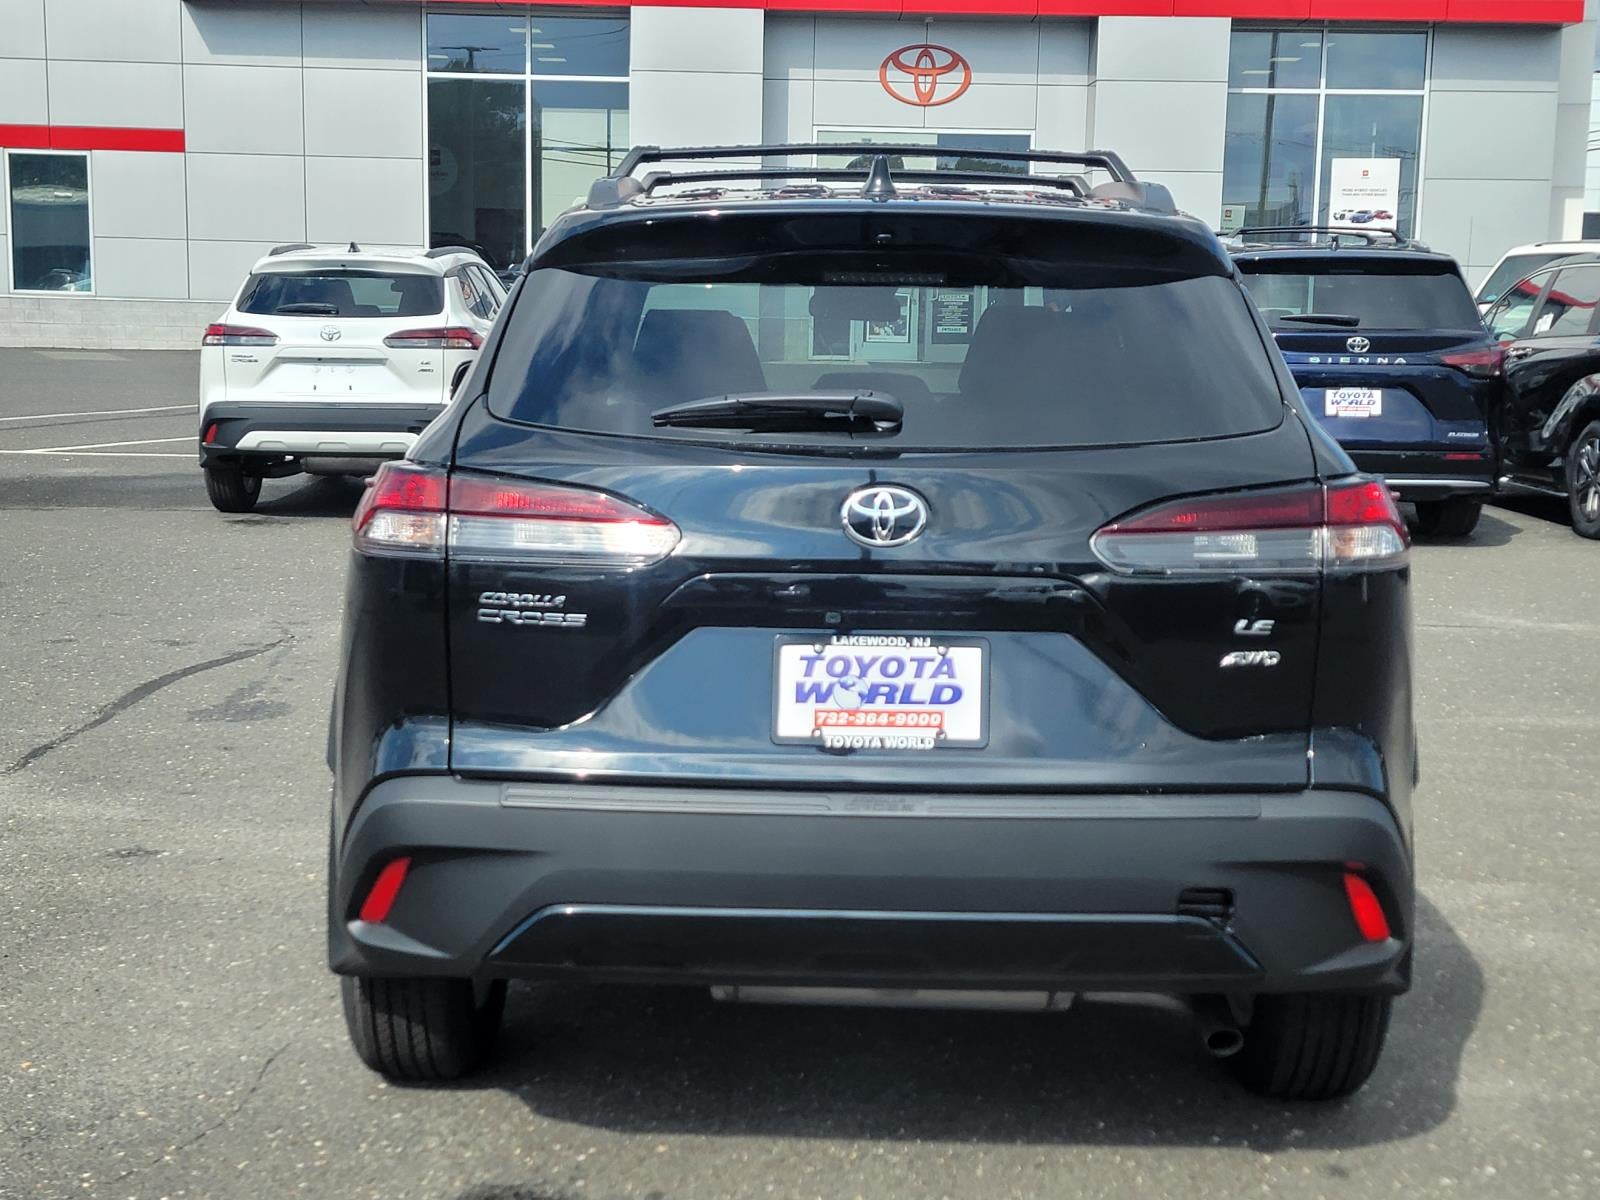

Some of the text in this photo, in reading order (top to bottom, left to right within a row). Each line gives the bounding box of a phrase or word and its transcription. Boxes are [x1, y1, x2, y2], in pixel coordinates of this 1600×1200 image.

[1308, 356, 1407, 364] SIENNA
[1331, 391, 1374, 399] TOYOTA
[479, 590, 567, 608] COROLLA
[477, 608, 588, 627] CROSS
[1233, 618, 1276, 635] LE
[831, 635, 931, 648] LAKEWOOD, NJ
[799, 654, 957, 679] TOYOTA
[1219, 650, 1281, 667] AWD
[815, 712, 942, 726] 732-364-9000
[824, 734, 935, 750] TOYOTA WORLD
